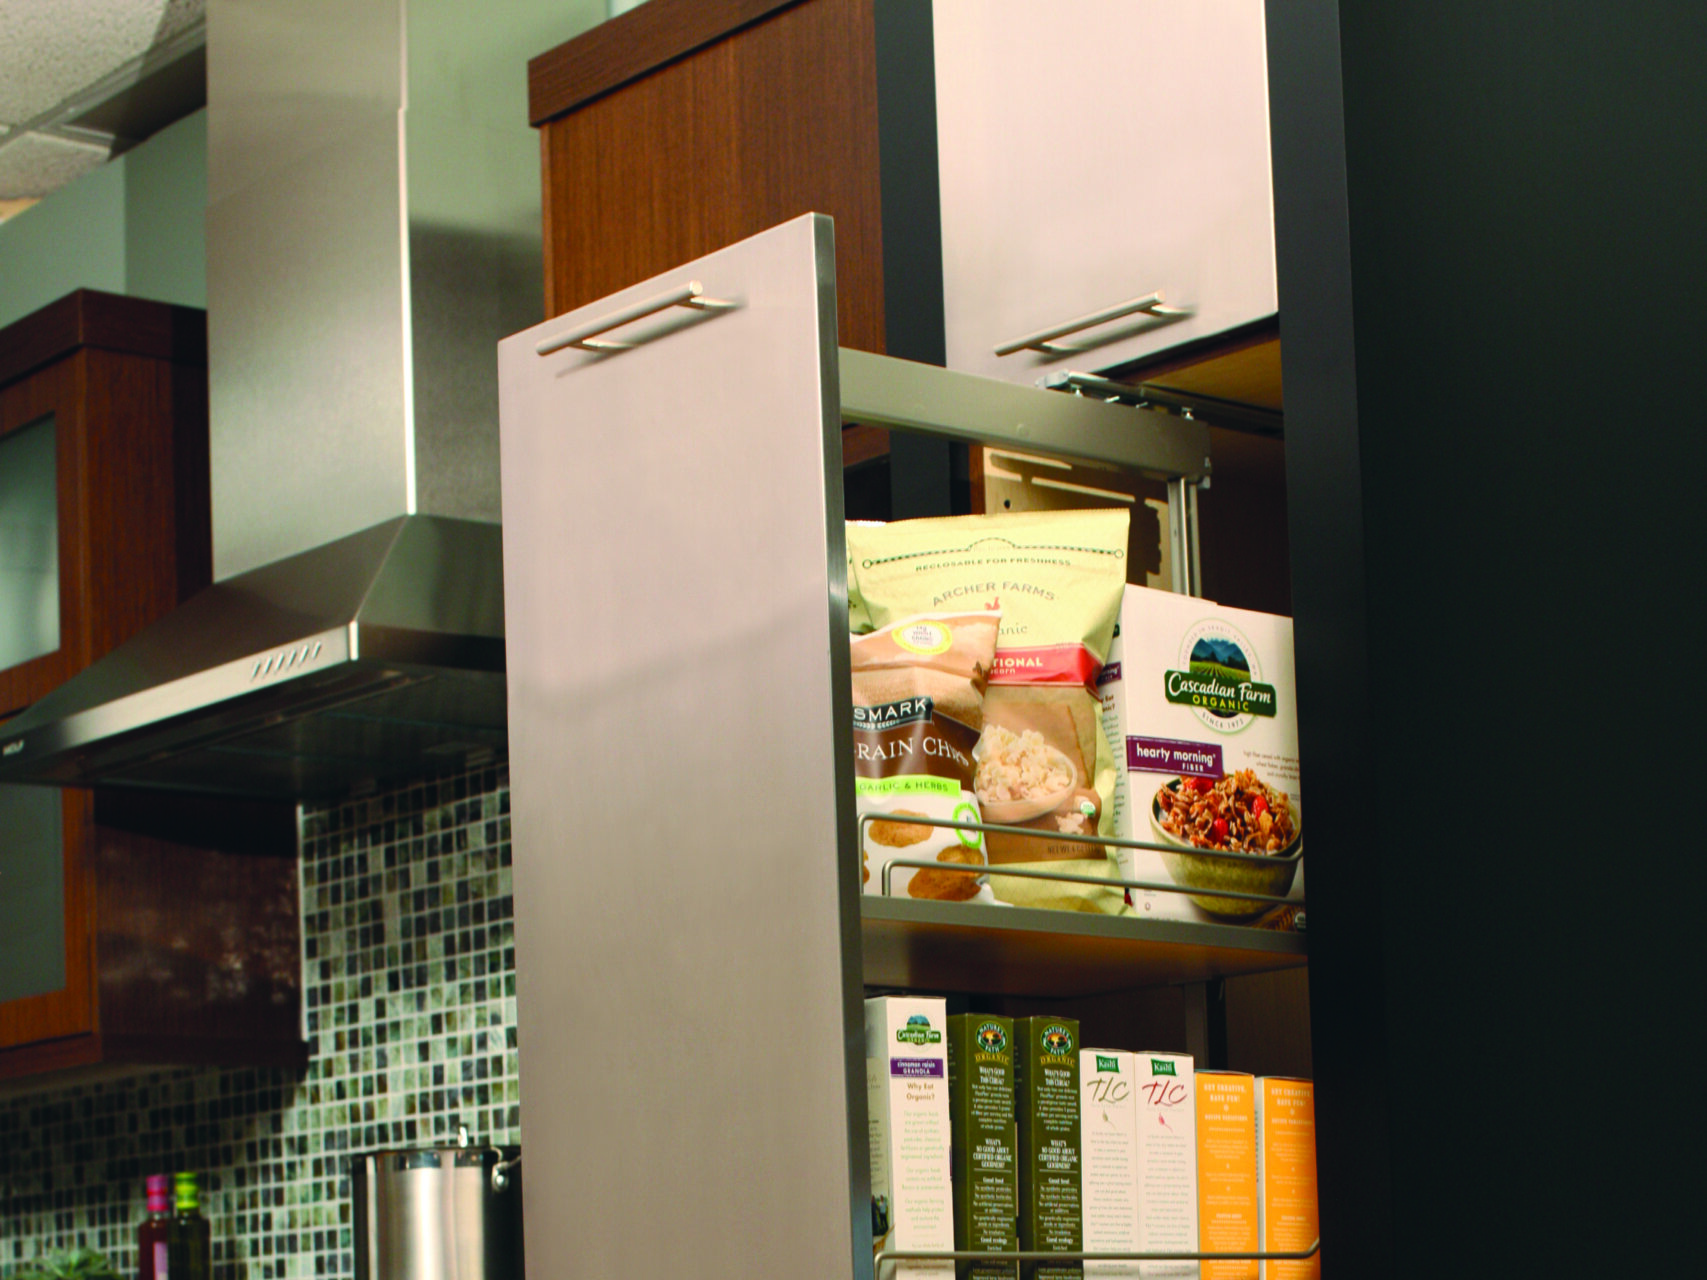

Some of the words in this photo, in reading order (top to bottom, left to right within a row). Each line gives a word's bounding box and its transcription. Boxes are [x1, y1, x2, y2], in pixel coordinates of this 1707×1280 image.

[915, 557, 983, 572] RECLOSABLE
[986, 558, 1005, 566] FOR
[1010, 557, 1072, 567] FRESHNESS
[932, 582, 996, 607] ARCHER
[1002, 580, 1056, 601] FARMS
[993, 657, 1043, 668] TIONAL
[1168, 672, 1236, 698] Cascadian
[1238, 682, 1272, 704] Farm
[1192, 694, 1249, 711] ORGANIC
[1136, 743, 1170, 762] hearty
[1173, 749, 1213, 767] morning
[1182, 763, 1204, 772] FIBER
[859, 782, 900, 792] GARLIC
[915, 782, 949, 792] HERBS
[1087, 1076, 1130, 1104] TLC
[1142, 1080, 1188, 1107] TLC
